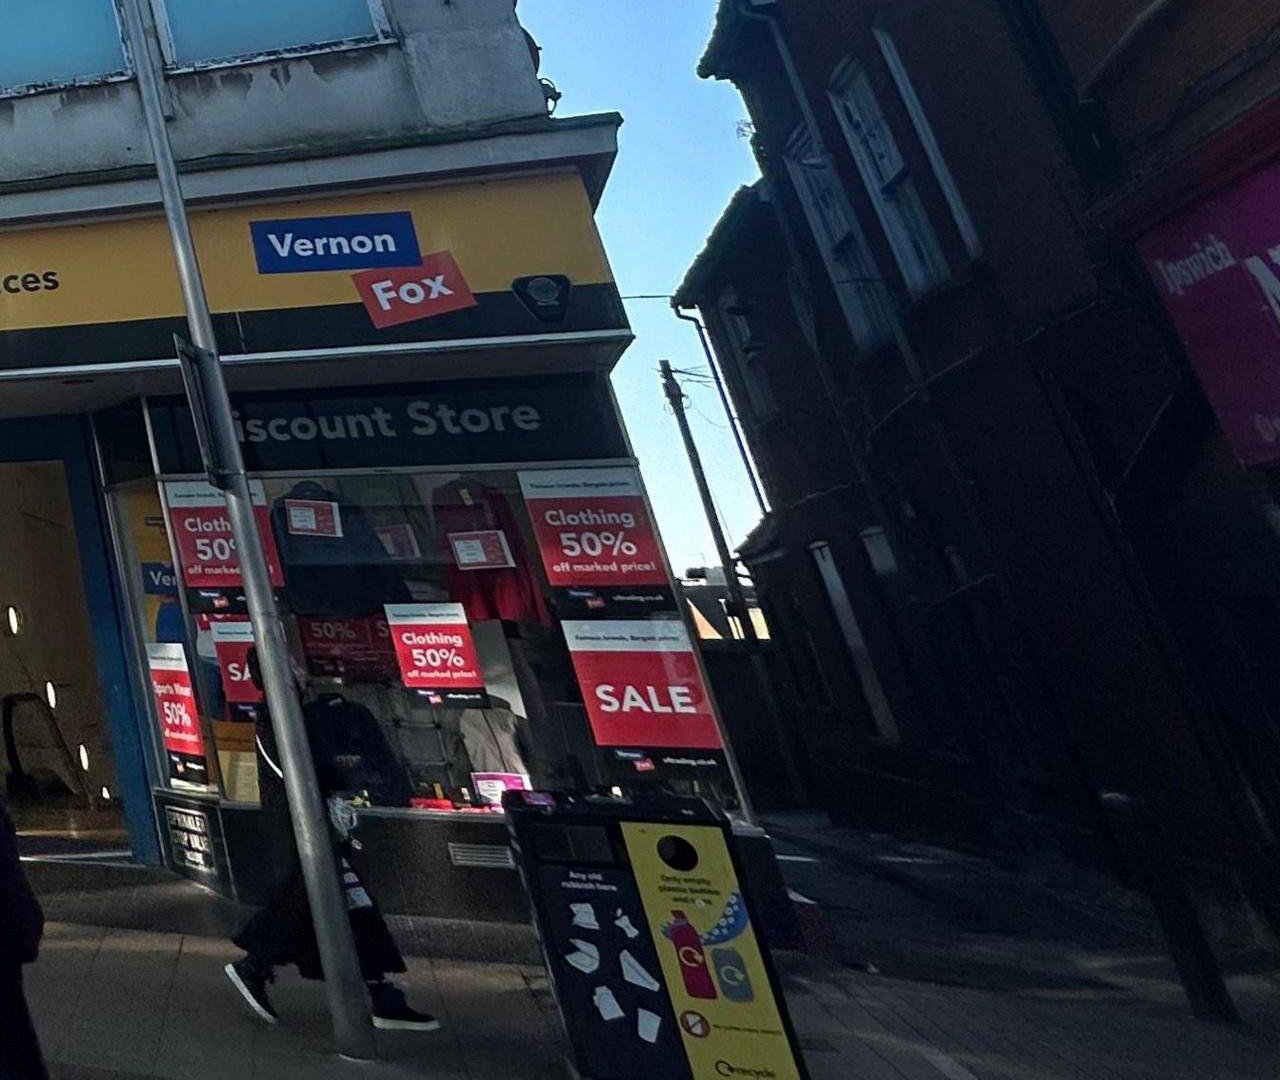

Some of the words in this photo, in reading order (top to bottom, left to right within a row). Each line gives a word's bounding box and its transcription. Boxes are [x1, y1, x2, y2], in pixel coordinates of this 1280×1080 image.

[267, 229, 397, 259] Vernon
[1154, 233, 1237, 296] Ipswich
[371, 274, 454, 312] Fox
[406, 400, 541, 437] Store
[184, 517, 232, 533] Cloth
[544, 508, 636, 528] Clothing
[559, 530, 638, 557] 50%
[553, 562, 571, 573] off
[573, 561, 618, 573] marked
[621, 560, 657, 574] price!
[311, 621, 356, 639] 50%
[401, 632, 464, 647] Clothing
[411, 648, 465, 667] 50%
[227, 662, 252, 682] SA
[595, 683, 697, 714] SALE
[163, 701, 192, 728] 50%
[568, 870, 587, 881] Any
[587, 871, 604, 882] old
[660, 874, 681, 884] Only
[595, 881, 618, 892] here
